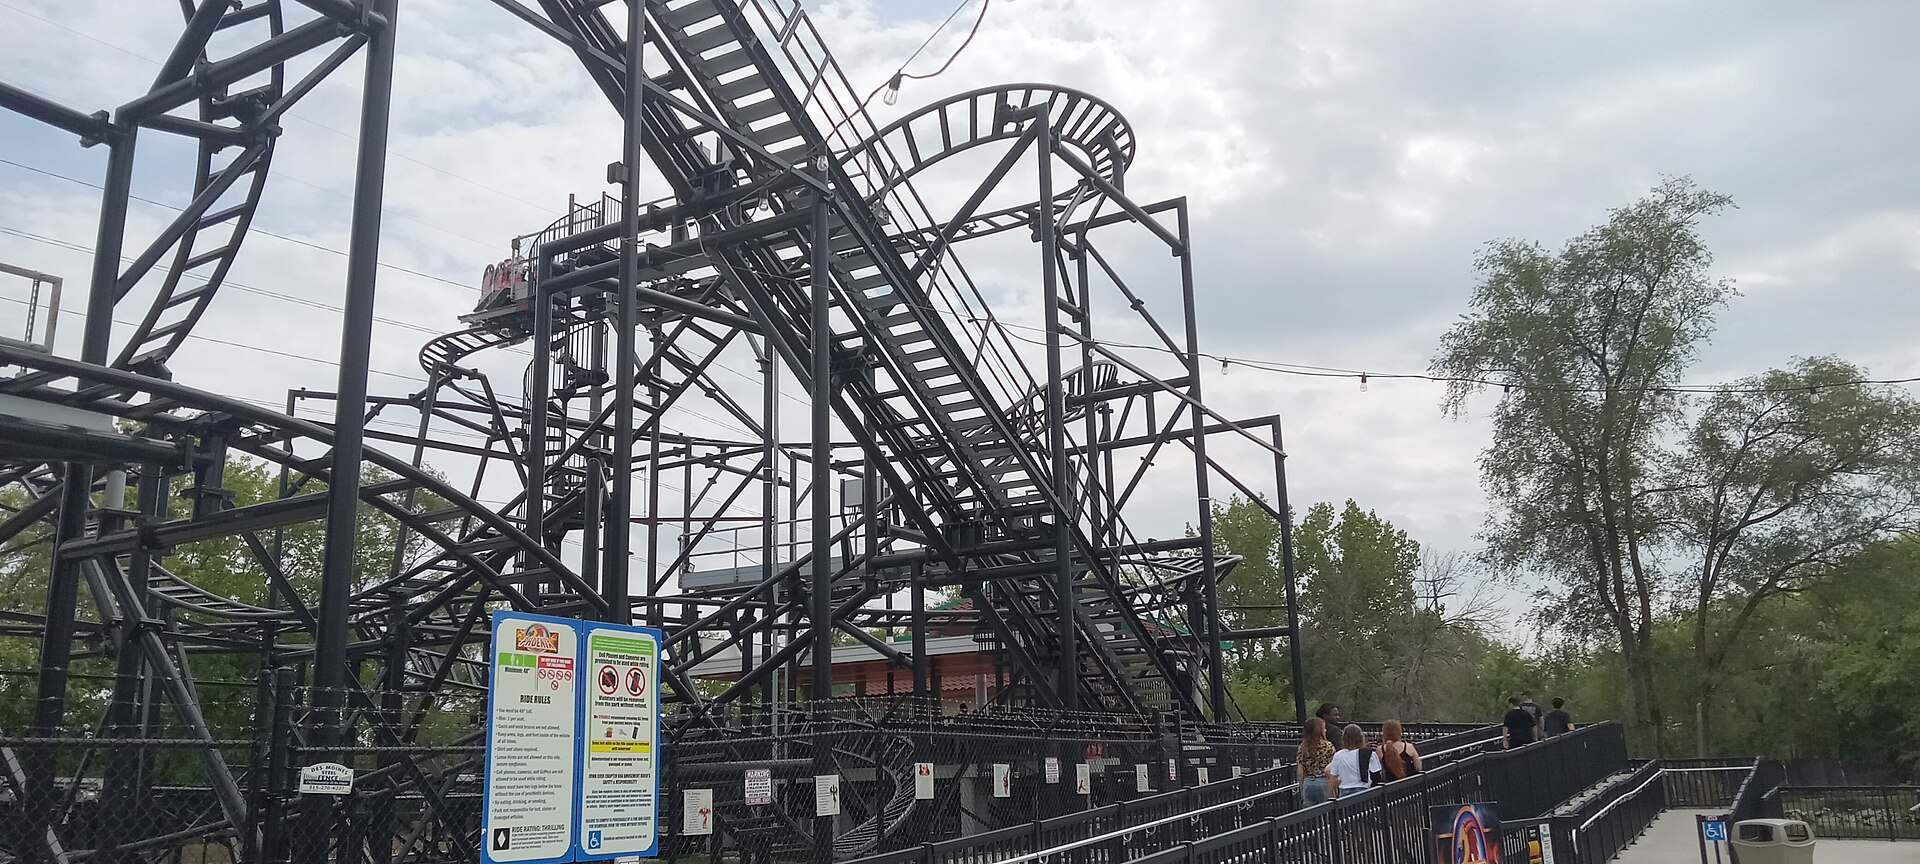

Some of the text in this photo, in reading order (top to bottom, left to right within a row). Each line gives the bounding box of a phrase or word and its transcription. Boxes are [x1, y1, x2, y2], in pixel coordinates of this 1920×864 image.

[520, 695, 551, 704] RIDE RULES
[325, 765, 348, 775] MOINES
